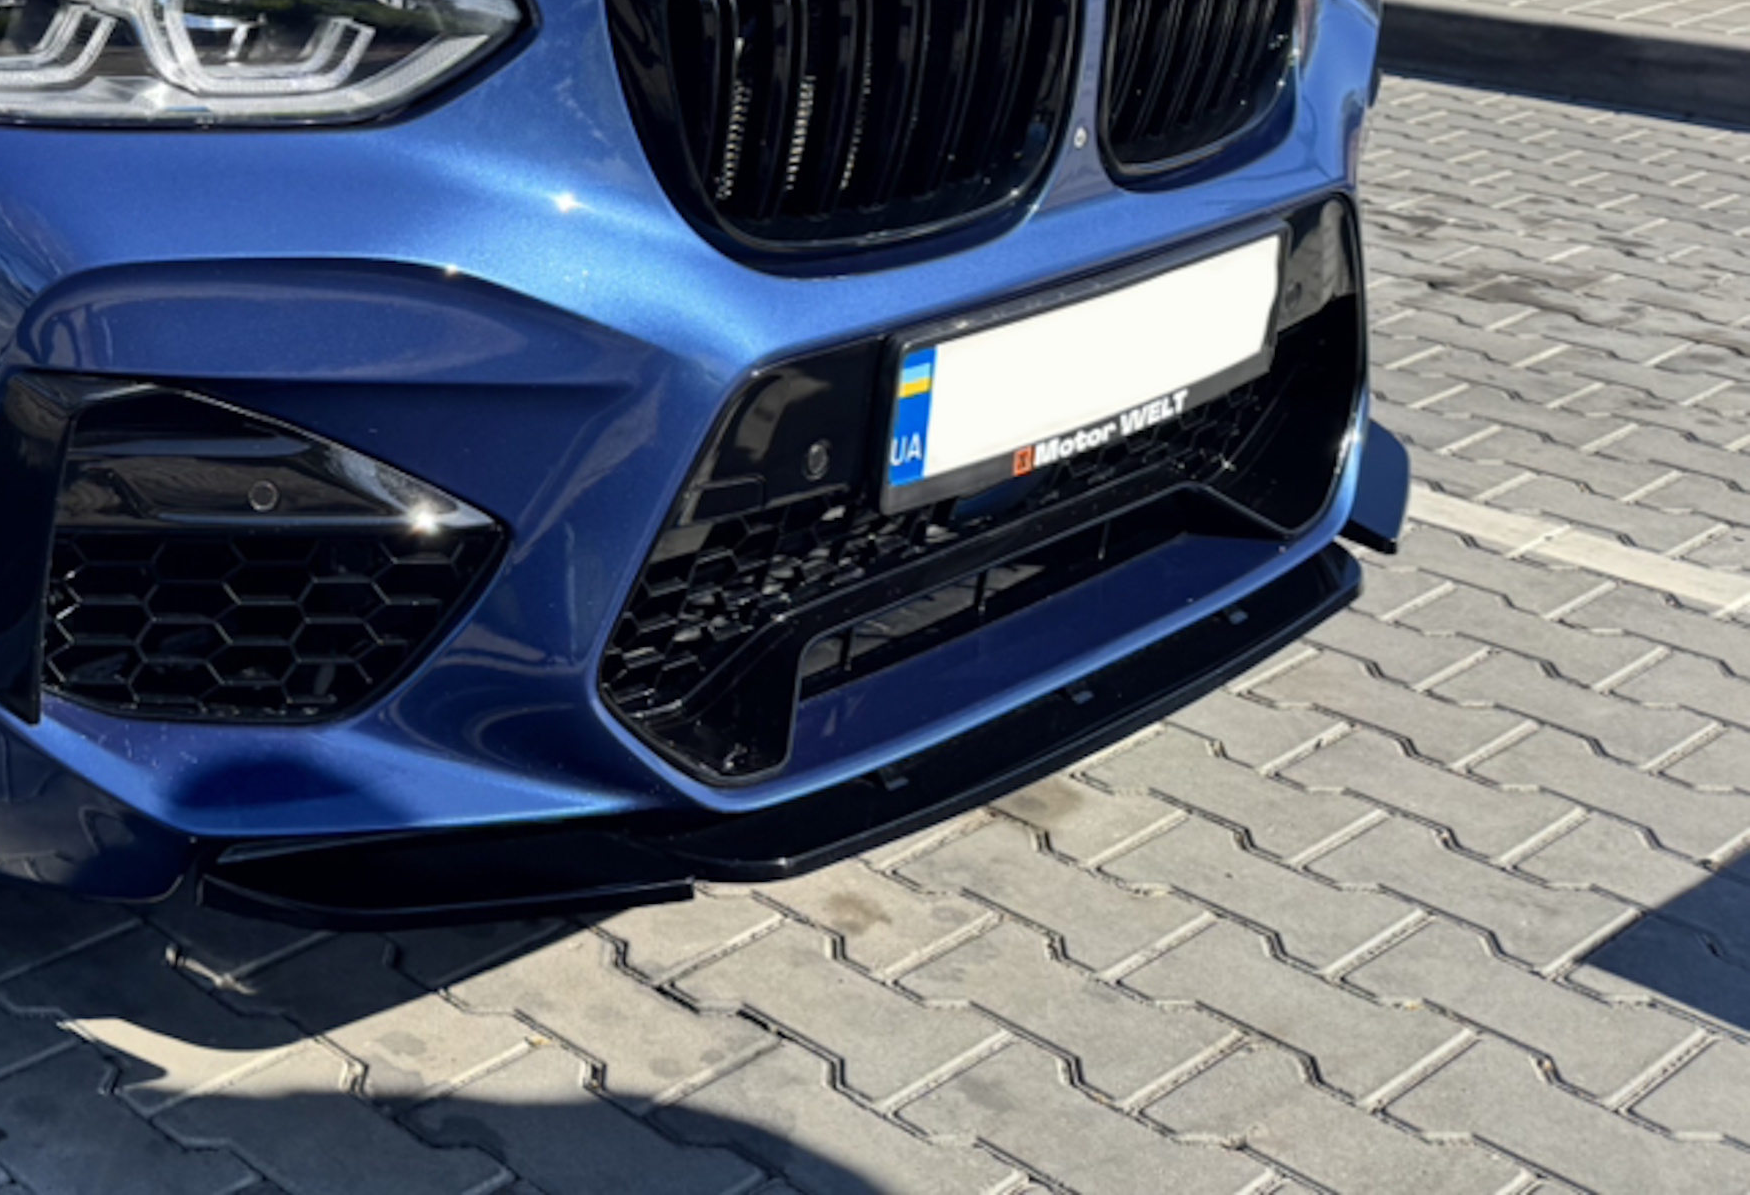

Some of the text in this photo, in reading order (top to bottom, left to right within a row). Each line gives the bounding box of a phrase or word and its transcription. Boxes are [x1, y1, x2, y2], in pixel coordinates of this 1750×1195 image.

[890, 431, 923, 466] UA
[1033, 388, 1189, 467] Motor WELT
